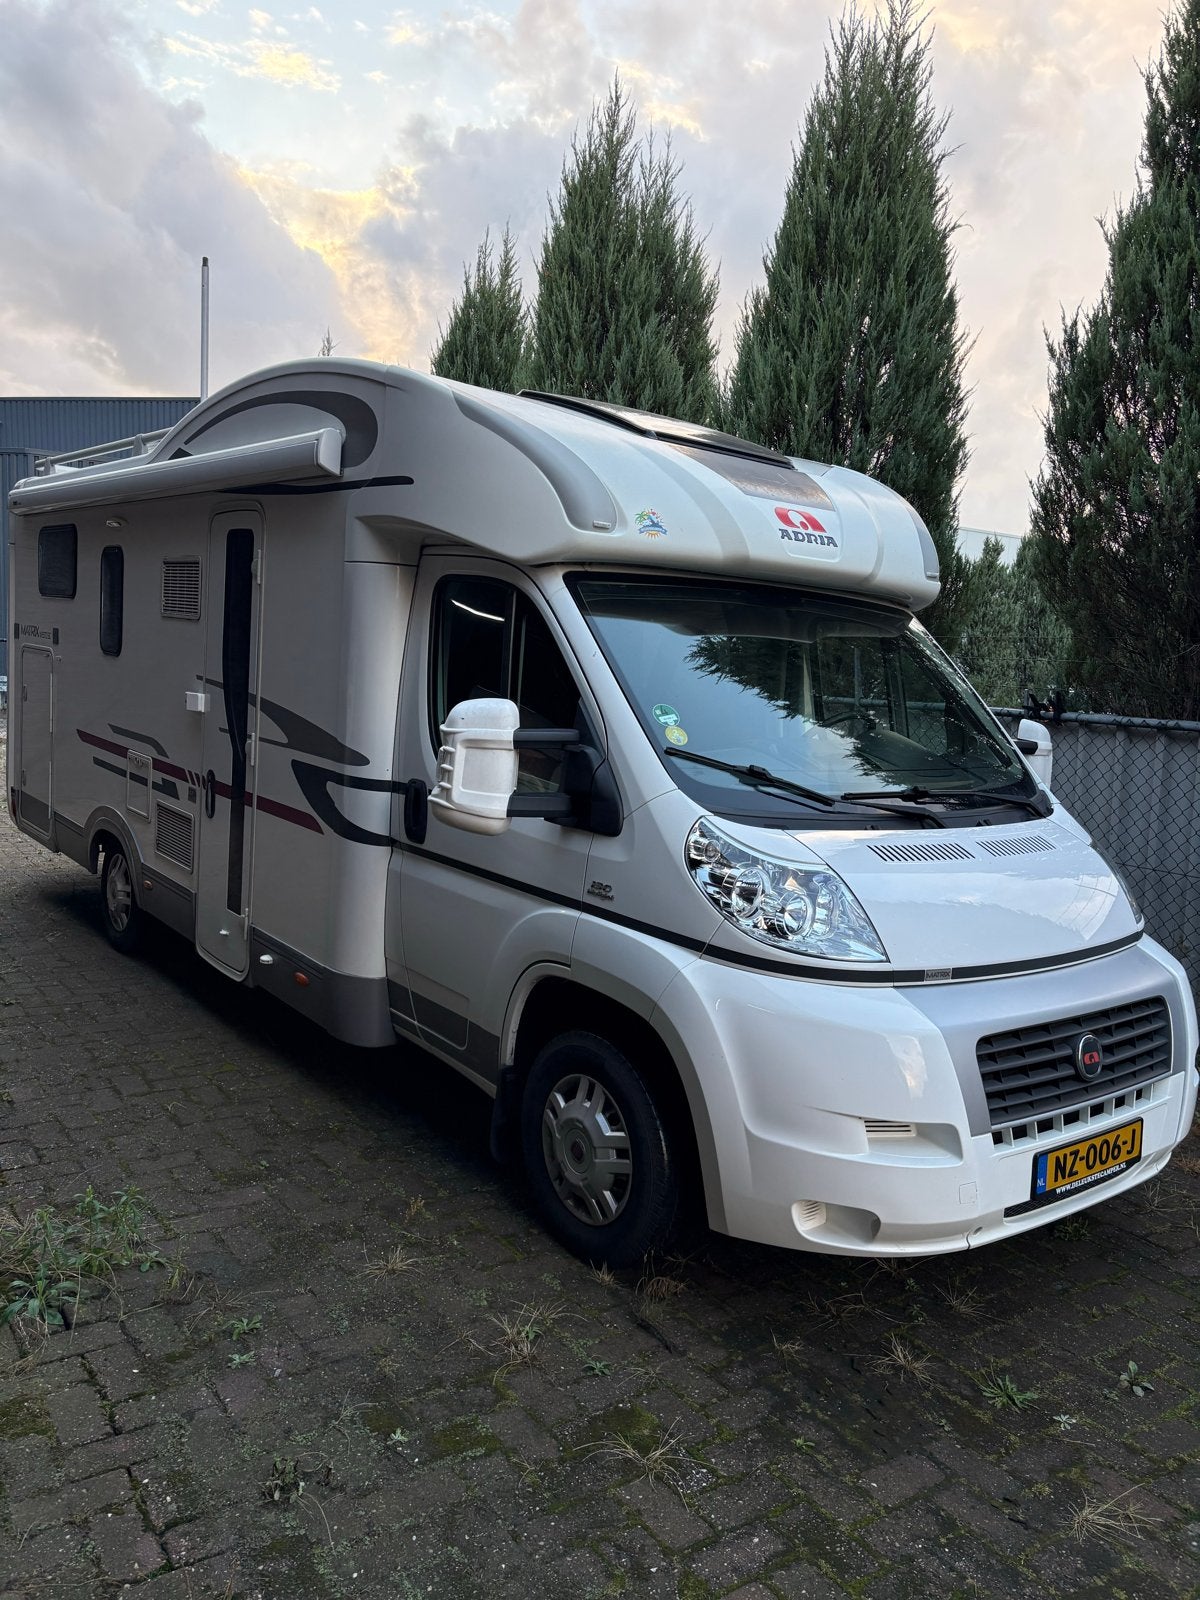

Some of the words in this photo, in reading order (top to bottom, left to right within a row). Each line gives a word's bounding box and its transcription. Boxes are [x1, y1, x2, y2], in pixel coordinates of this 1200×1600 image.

[778, 527, 838, 548] ADRIA
[926, 971, 951, 979] MATRIX
[1053, 1128, 1137, 1183] NZ-006-J
[1036, 1177, 1046, 1188] NL
